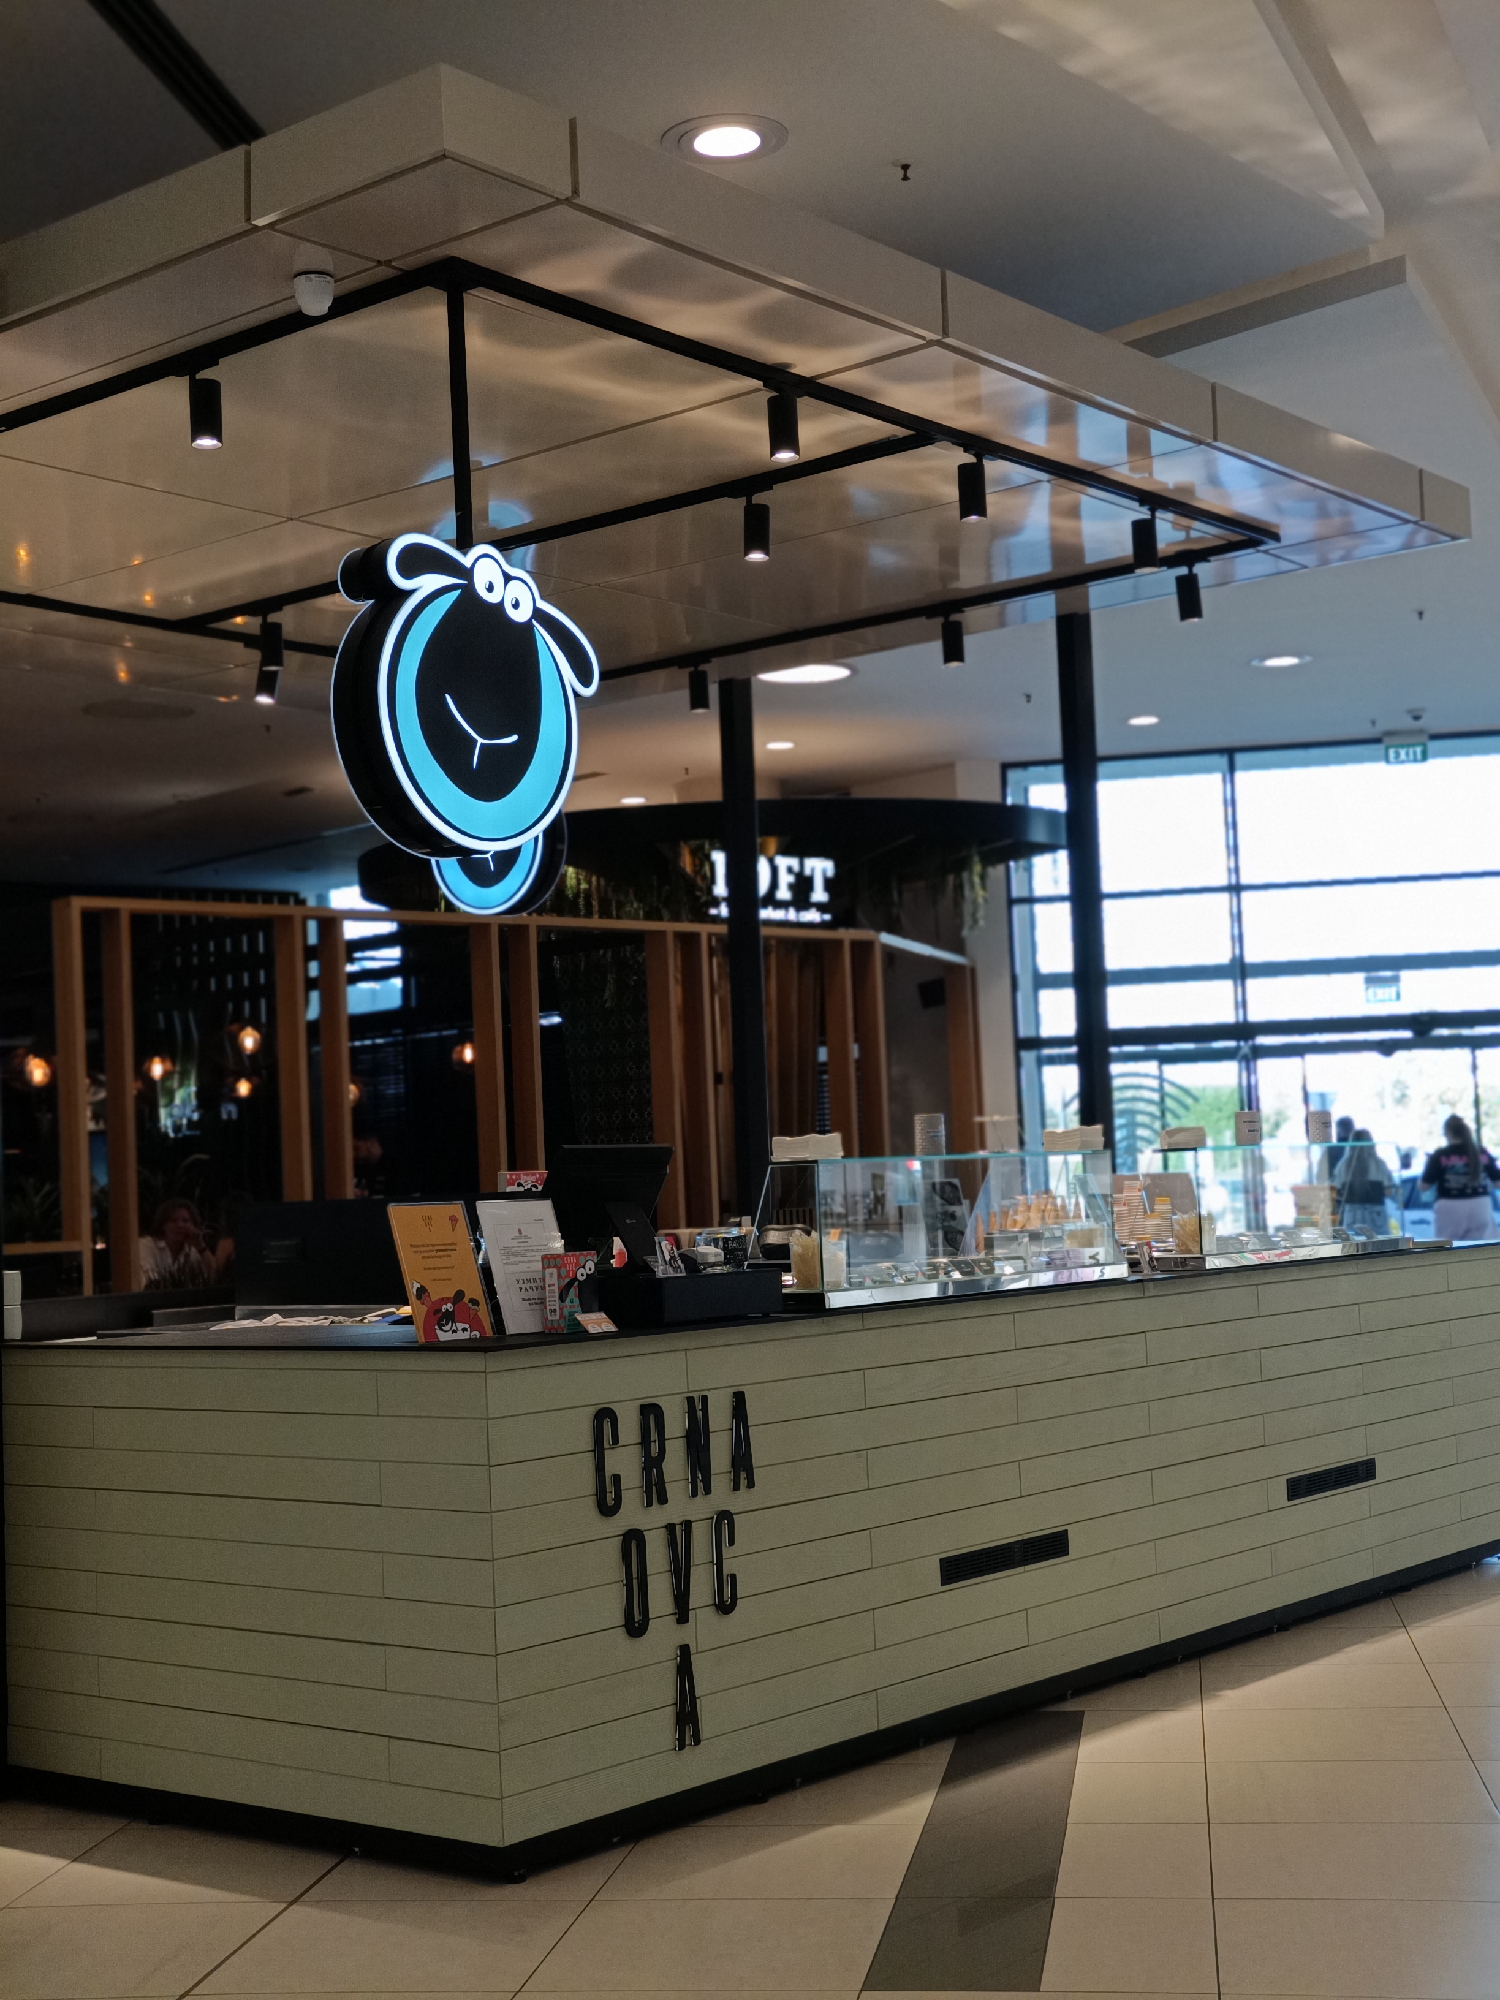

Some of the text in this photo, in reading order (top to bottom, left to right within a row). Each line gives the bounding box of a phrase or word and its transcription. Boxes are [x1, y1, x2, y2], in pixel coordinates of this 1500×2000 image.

[1388, 746, 1424, 763] EXIT
[515, 1277, 543, 1285] УЗМИТ
[593, 1390, 756, 1518] CRNA
[621, 1509, 738, 1639] OVC
[674, 1643, 701, 1752] A
